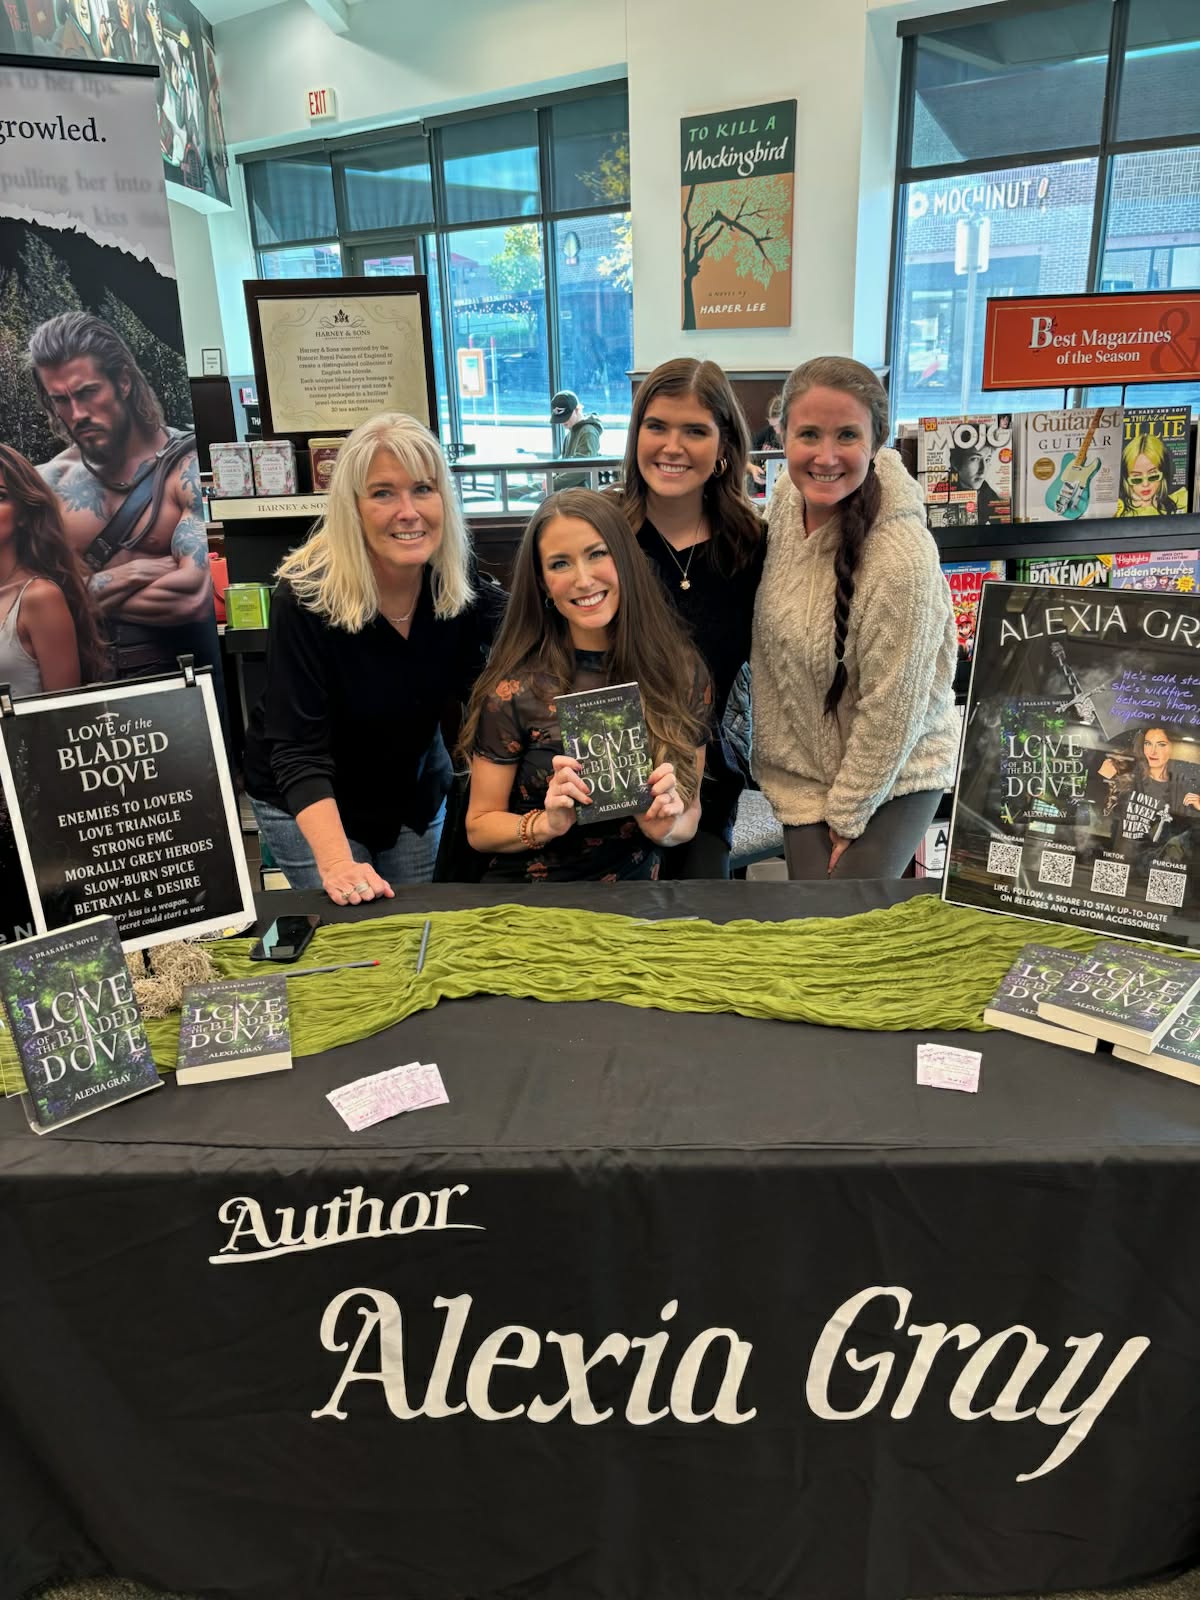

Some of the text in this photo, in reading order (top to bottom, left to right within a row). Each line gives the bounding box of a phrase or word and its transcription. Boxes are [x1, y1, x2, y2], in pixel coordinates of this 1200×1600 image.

[309, 90, 326, 115] EXIT
[689, 115, 776, 142] TO KILL A
[684, 136, 789, 177] Mockingbird
[1, 167, 152, 194] pulling her into
[700, 302, 767, 314] HARPER LEE
[316, 330, 344, 338] HARNEY
[1028, 316, 1172, 350] Best Magazines
[1056, 350, 1141, 365] of the Season
[926, 423, 1012, 451] MOJO
[1124, 420, 1186, 440] ILLIE
[258, 504, 299, 512] HARNEY
[944, 572, 1000, 592] ARI
[1030, 560, 1108, 586] POKÉMON
[1112, 567, 1194, 578] Hidden Pictures
[1001, 605, 1200, 649] ALEXIA GR
[1122, 670, 1177, 684] He's cold
[1116, 694, 1161, 708] between
[67, 718, 152, 744] LOVE of the
[1160, 714, 1184, 724] will
[57, 731, 169, 771] BLADED
[572, 726, 645, 761] LOVE
[1008, 734, 1084, 759] LOVE
[80, 758, 158, 792] DOVE
[590, 752, 647, 774] BLADED
[1022, 760, 1084, 774] BLADED
[1006, 776, 1086, 798] DOVE
[1130, 790, 1160, 810] I ONLY
[58, 790, 194, 828] ENEMIES TO LOVERS
[599, 800, 639, 813] ALEXIA GRAY
[1126, 802, 1156, 822] KNEEL
[78, 810, 182, 842] LOVE TRIANGLE
[990, 832, 1024, 843] INSTAGRAM
[92, 830, 174, 858] STRONG FMC
[1043, 842, 1076, 852] FACEBOOK
[1102, 851, 1125, 860] TIKTOK
[64, 838, 214, 882] MORALLY GREY HEROES
[1152, 858, 1187, 871] PURCHASE
[84, 860, 195, 896] SLOW-BURN SPICE
[74, 875, 202, 916] BETRAYAL & DESIRE
[128, 908, 142, 918] kiss
[144, 906, 150, 914] is
[158, 898, 189, 910] weapon.
[993, 884, 1010, 893] LIKE,
[1012, 886, 1044, 900] FOLLOW,
[1056, 894, 1081, 908] SHARE
[1083, 899, 1093, 909] TO
[1096, 902, 1116, 913] STAY
[1117, 906, 1168, 923] UP-TO-DATE
[119, 920, 140, 932] secret
[142, 914, 162, 926] could
[164, 908, 182, 920] start
[190, 904, 205, 913] war.
[1000, 894, 1160, 931] ON RELEASES AND CUSTOM ACCESSORIES
[35, 942, 75, 959] DRAKAREN
[76, 935, 99, 948] NOVEL
[1086, 961, 1187, 996] LOVE
[1096, 978, 1172, 1004] BLADED
[24, 972, 134, 1035] LOVE
[192, 998, 282, 1024] LOVE
[1064, 980, 1162, 1016] DOVE
[1075, 1002, 1130, 1020] ALEXIA GRAY
[37, 1006, 139, 1048] OF BLADED
[210, 1014, 283, 1032] BLADED
[36, 1043, 58, 1056] THE
[190, 1024, 284, 1049] DOVE
[38, 1025, 146, 1085] DOVE
[208, 1045, 264, 1058] ALEXIA GRAY
[74, 1072, 132, 1101] ALEXIA GRAY
[217, 1183, 470, 1253] Author
[311, 1286, 1151, 1482] Alexia Gray
